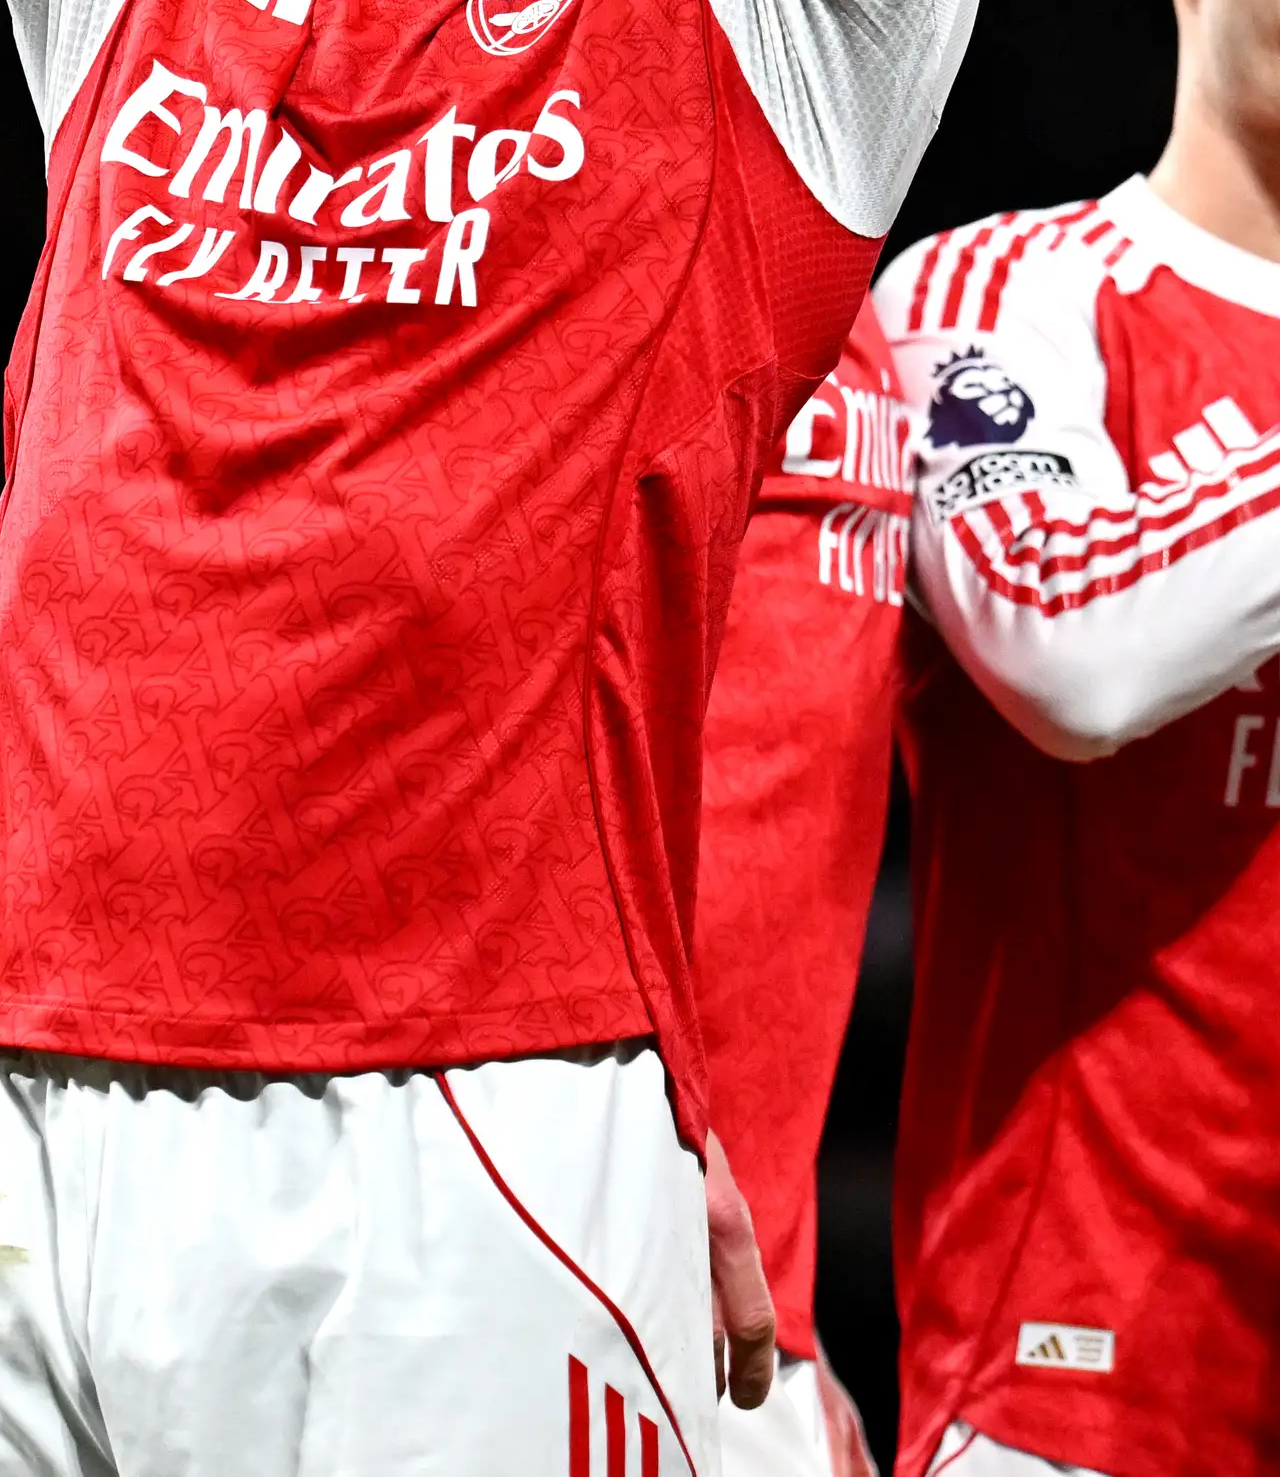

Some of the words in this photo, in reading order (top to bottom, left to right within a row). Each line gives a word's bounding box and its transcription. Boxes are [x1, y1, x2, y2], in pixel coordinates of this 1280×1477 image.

[101, 59, 585, 227] Emirates
[102, 204, 237, 287] FLY
[215, 207, 490, 308] BETTER
